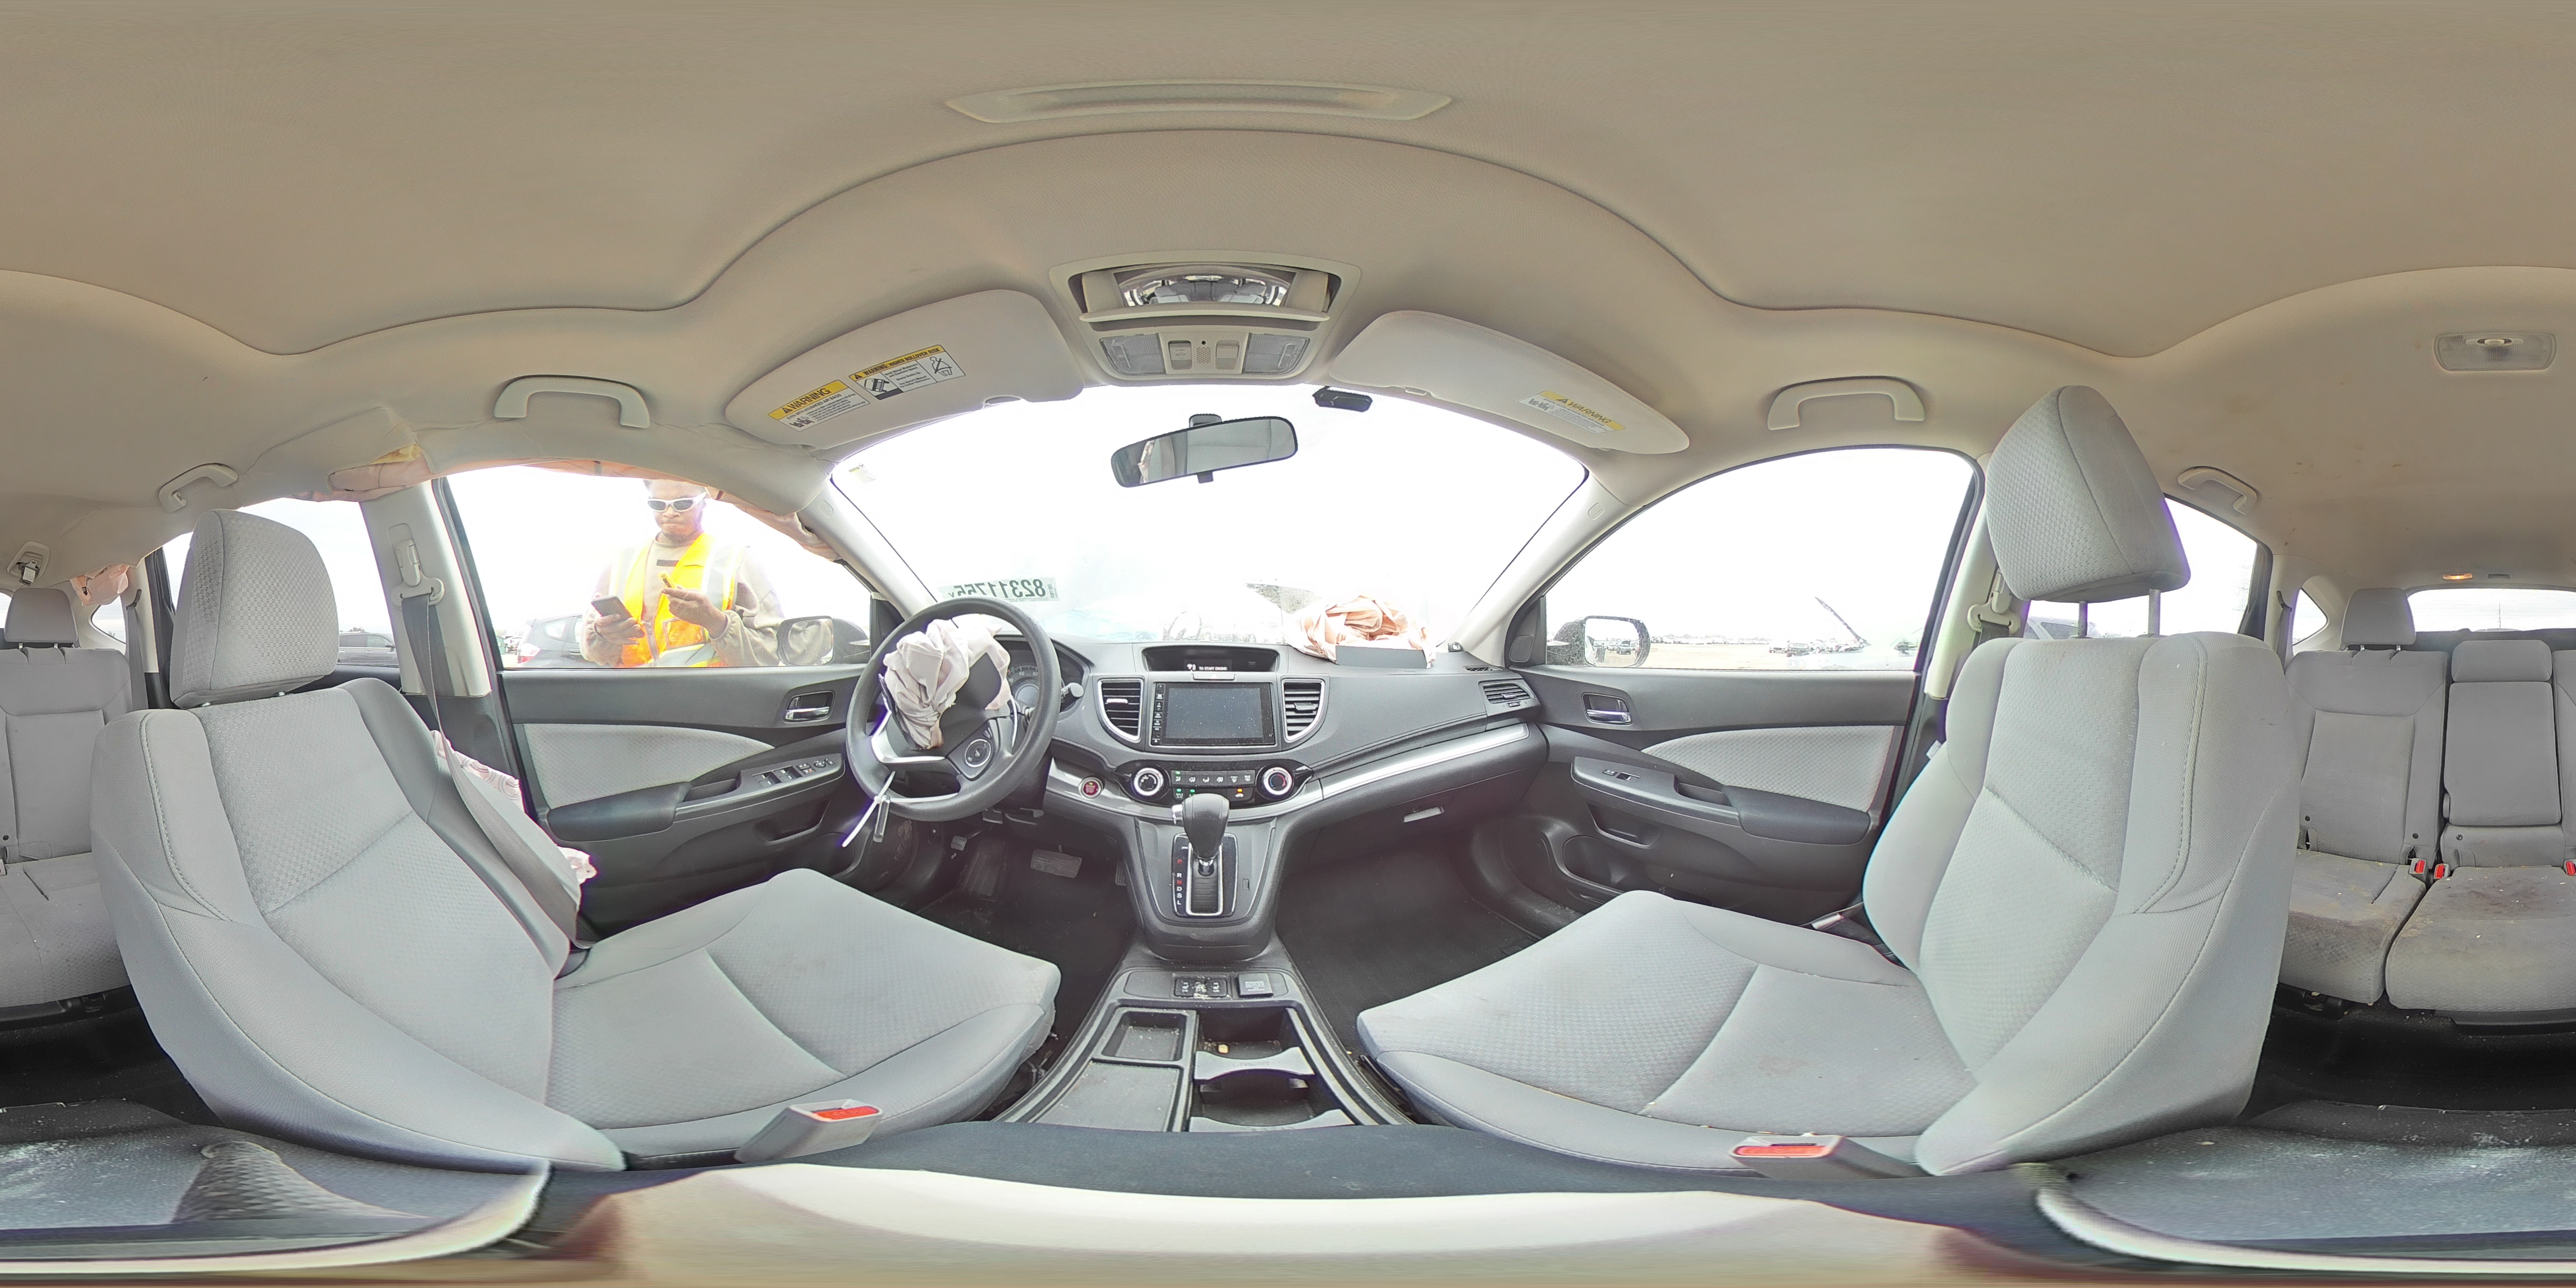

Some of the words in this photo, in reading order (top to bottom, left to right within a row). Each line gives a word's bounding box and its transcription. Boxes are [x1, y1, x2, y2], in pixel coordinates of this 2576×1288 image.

[904, 351, 929, 361] ROLLOVER
[787, 388, 832, 410] WARNING
[1568, 402, 1612, 424] WARNING
